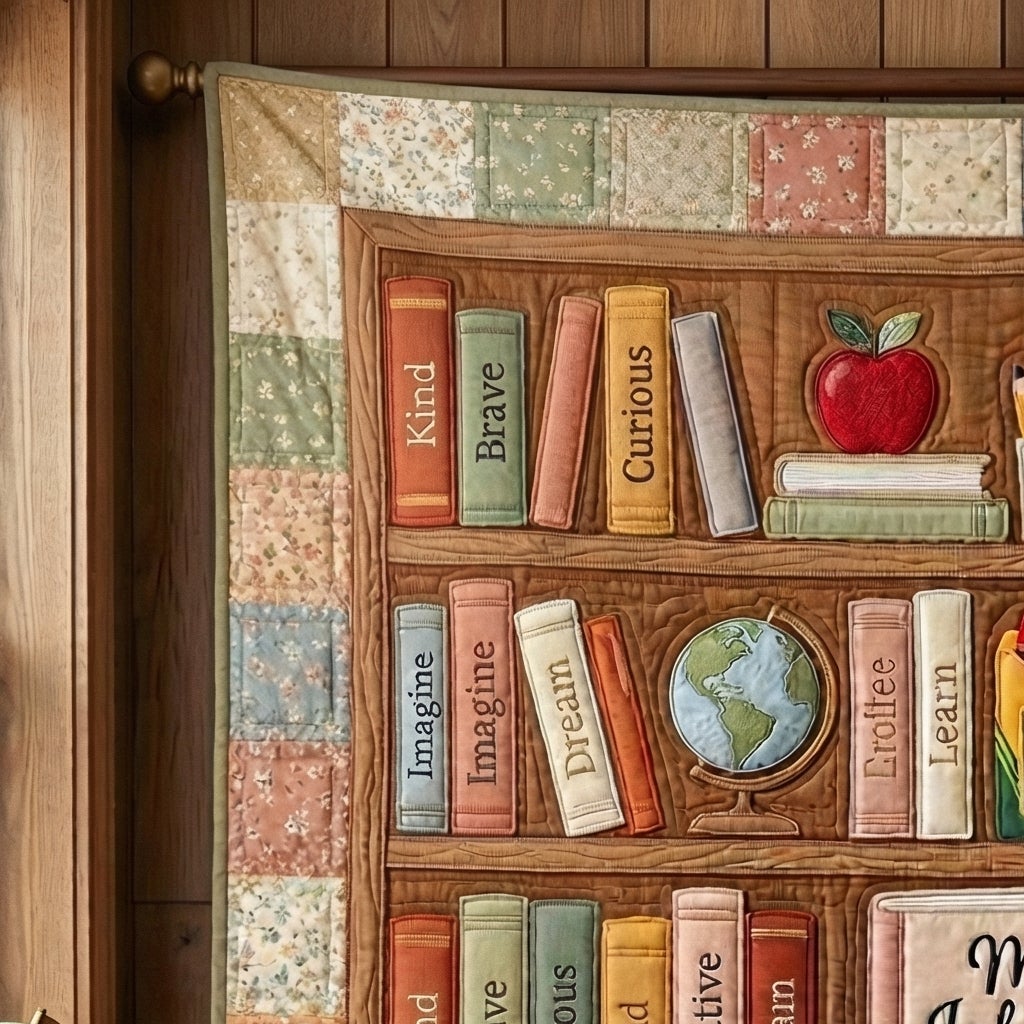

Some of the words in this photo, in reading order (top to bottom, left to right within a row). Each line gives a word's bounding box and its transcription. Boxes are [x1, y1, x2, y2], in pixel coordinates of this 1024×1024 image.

[404, 360, 436, 448] Kind
[475, 362, 506, 463] Brave
[621, 345, 655, 484] Curious
[407, 651, 441, 780] Imagine
[465, 640, 506, 786] Imagine
[928, 662, 959, 767] Learn
